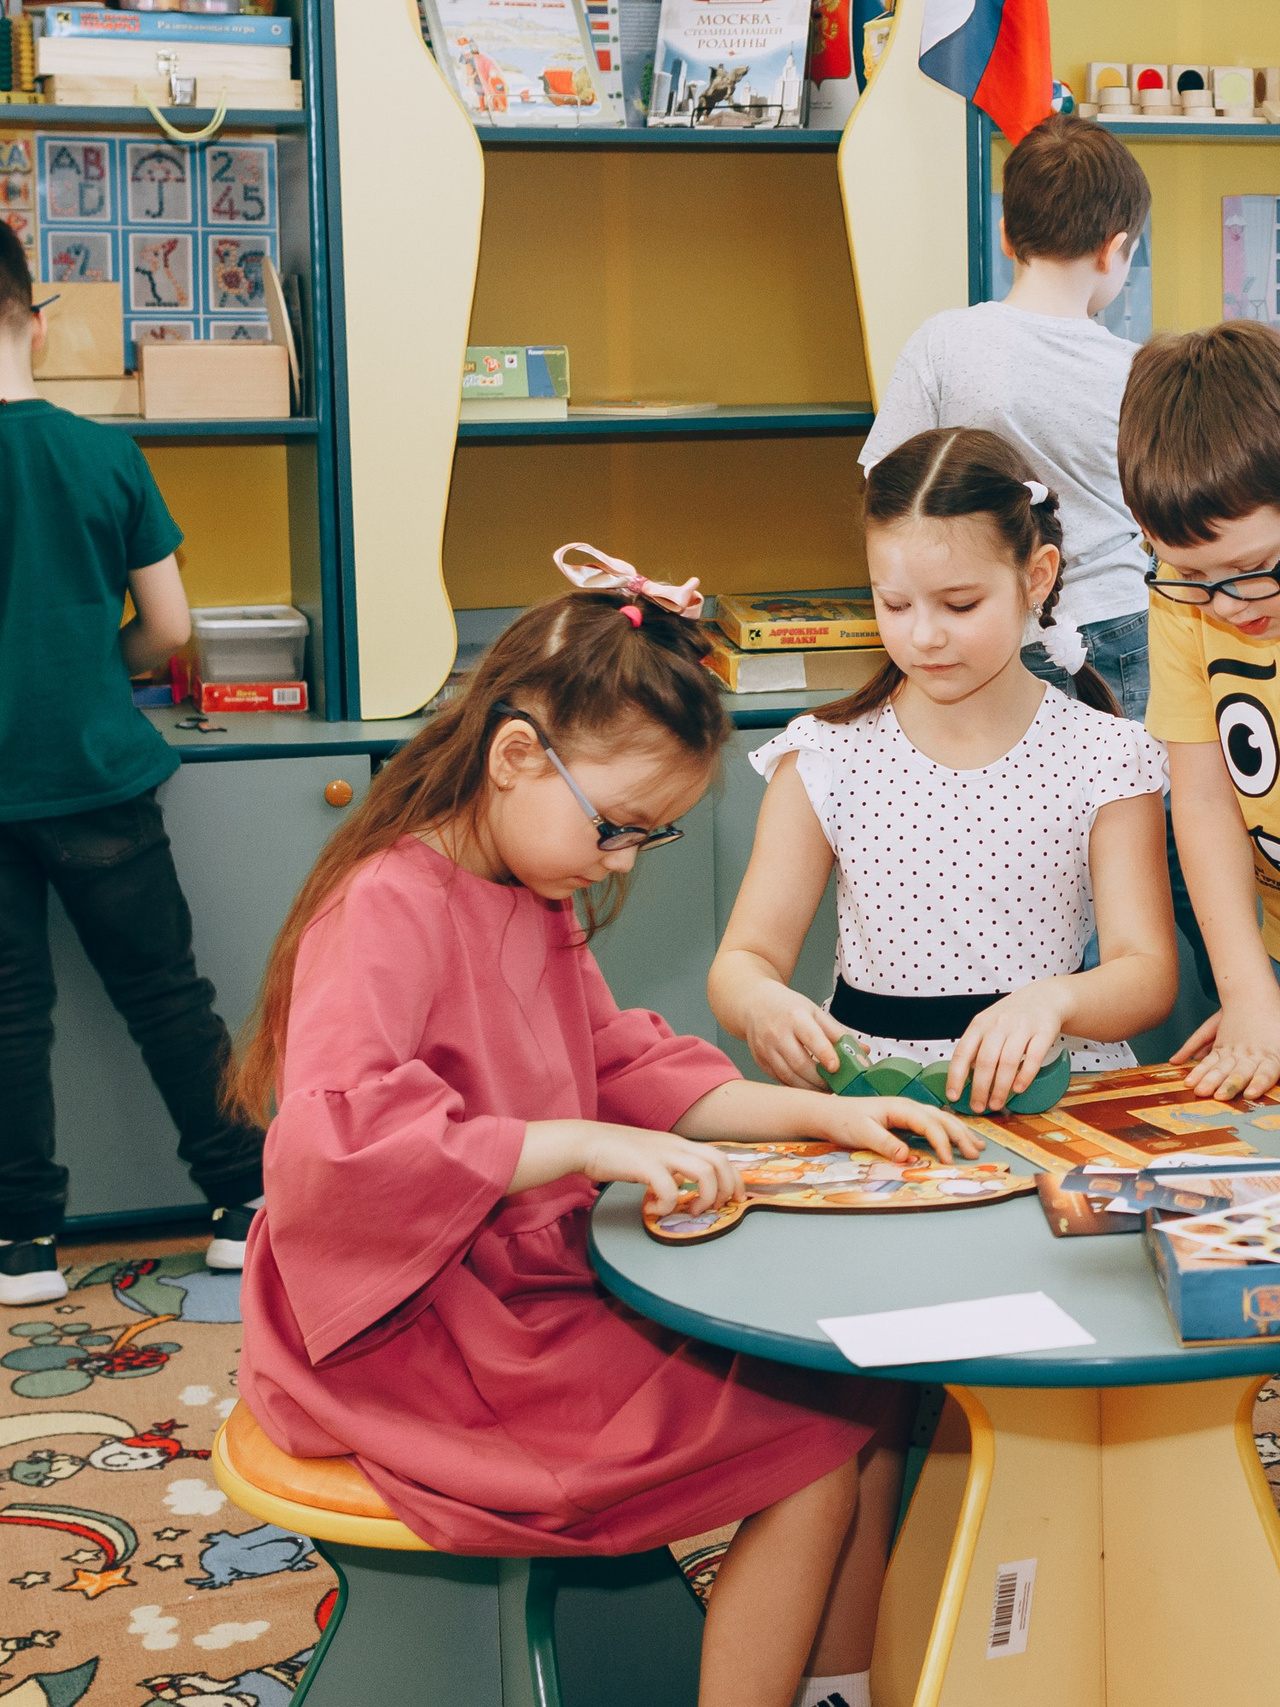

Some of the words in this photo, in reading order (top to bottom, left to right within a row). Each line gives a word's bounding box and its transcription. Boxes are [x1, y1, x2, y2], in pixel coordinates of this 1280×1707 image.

[697, 14, 771, 26] МОСКВА
[684, 28, 738, 36] СТОЛИЦА
[740, 27, 782, 36] НАШЕЙ
[698, 38, 767, 49] РОДИНЫ
[769, 627, 830, 637] ДОРОЖНЫЕ
